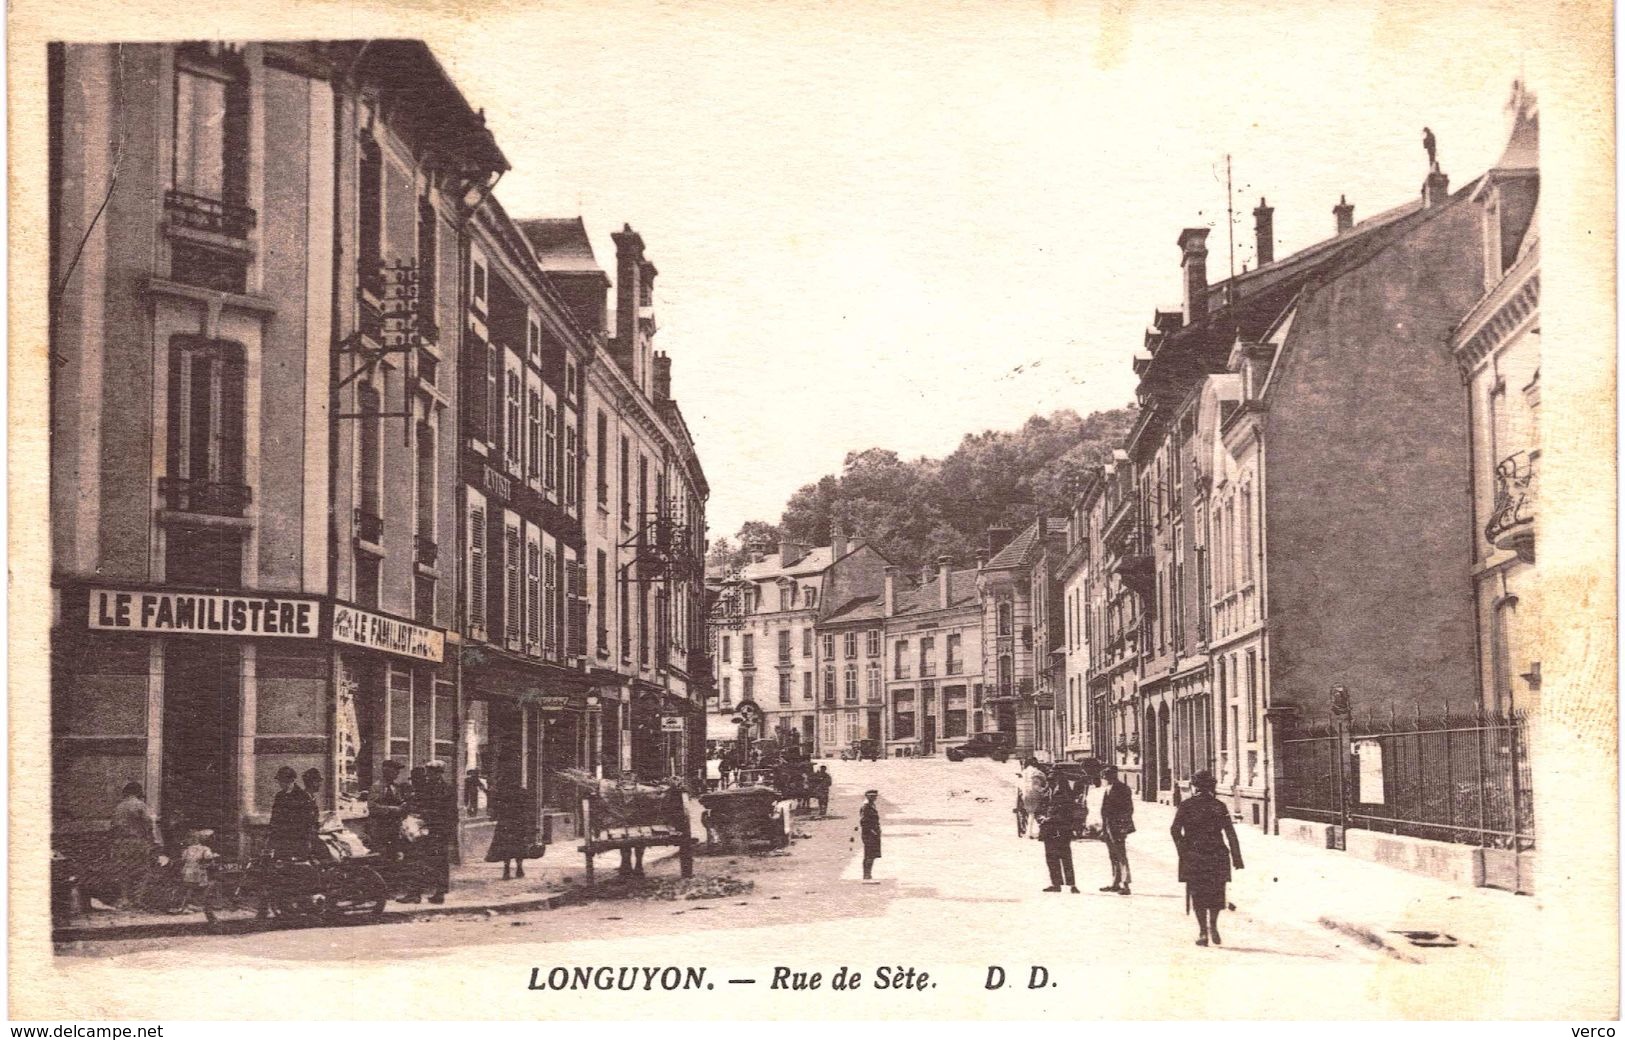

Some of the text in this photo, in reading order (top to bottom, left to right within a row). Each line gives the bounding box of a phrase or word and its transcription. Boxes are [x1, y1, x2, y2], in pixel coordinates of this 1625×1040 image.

[98, 592, 311, 634] LE FAMILISTÈRE
[353, 612, 368, 643] LE
